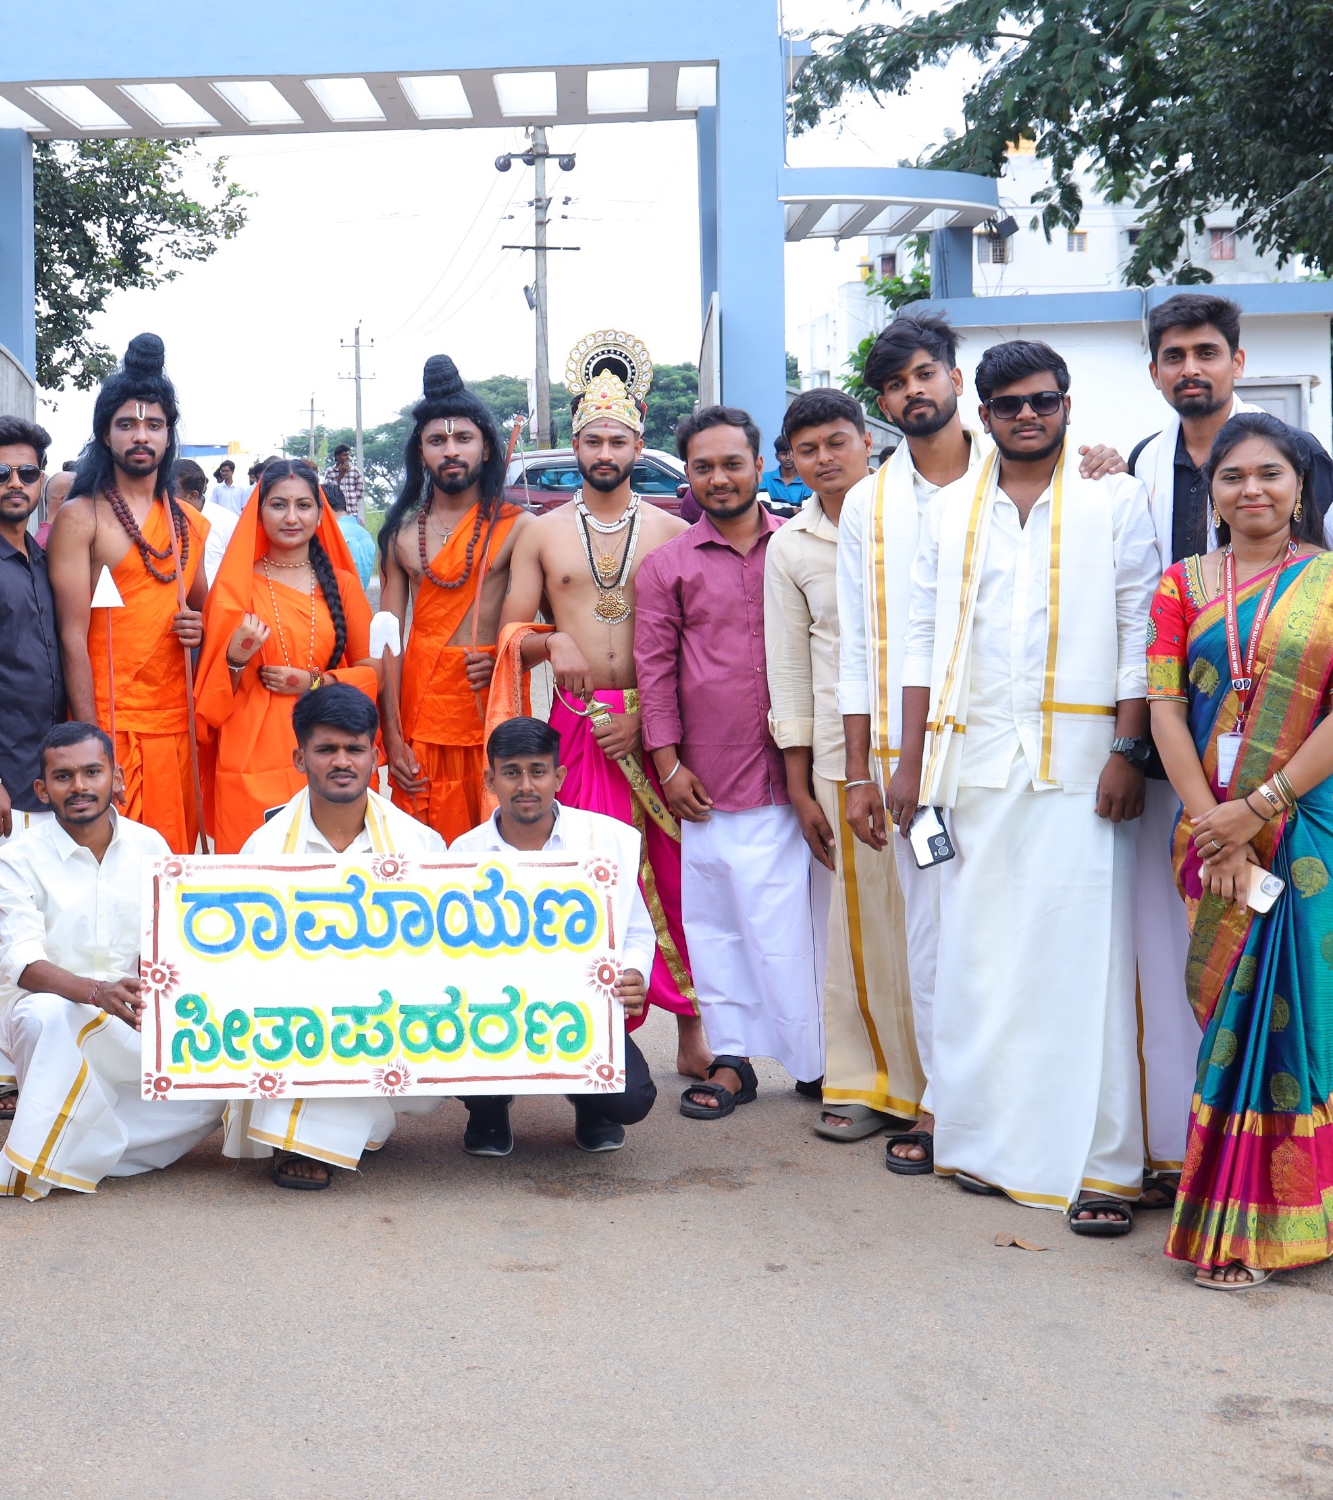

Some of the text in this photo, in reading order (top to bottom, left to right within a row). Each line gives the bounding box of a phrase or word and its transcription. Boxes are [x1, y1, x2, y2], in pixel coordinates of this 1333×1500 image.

[1228, 623, 1234, 632] OF
[1248, 630, 1260, 661] INSTITUTE
[1255, 622, 1262, 631] OF
[1229, 632, 1239, 661] INSTITUTE
[1232, 661, 1240, 675] JAIN
[181, 867, 599, 954] ರಾಮಾಯಣ
[171, 985, 593, 1065] ಸೀತಾಪಹರಣ
